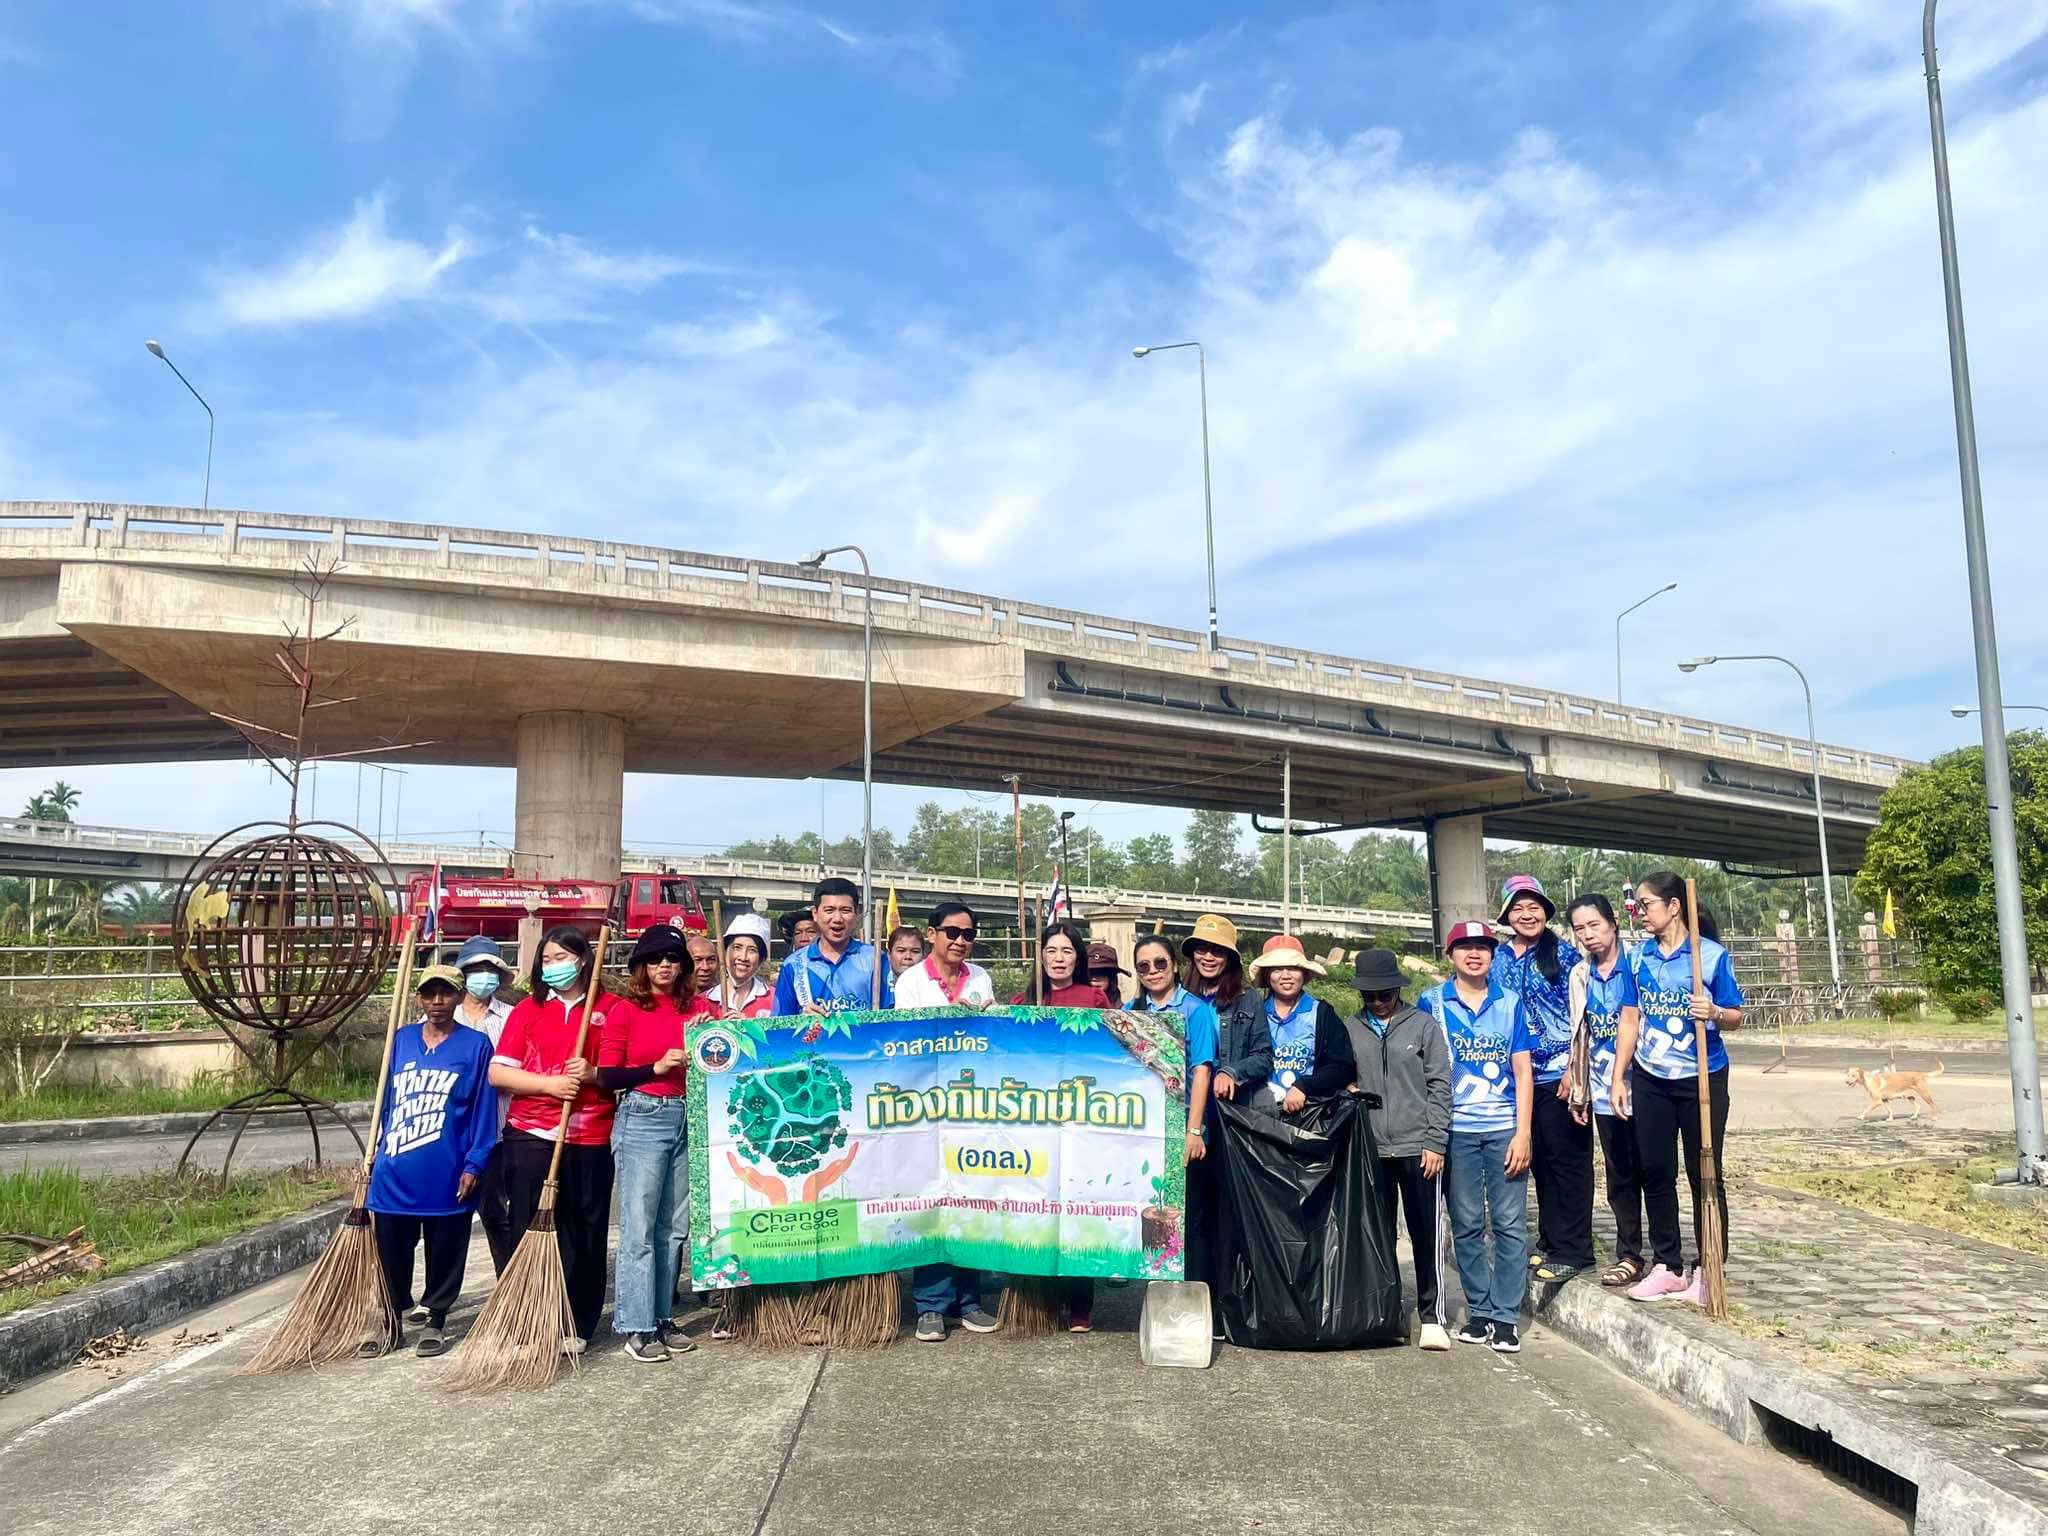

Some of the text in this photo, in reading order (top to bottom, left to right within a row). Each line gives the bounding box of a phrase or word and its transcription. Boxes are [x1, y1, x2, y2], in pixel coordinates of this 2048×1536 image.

[884, 1030, 989, 1056] อาสาสมัคร
[866, 1069, 1146, 1129] ท้องถิ่นรักษ์โลก
[750, 1208, 838, 1234] Change
[771, 1219, 839, 1233] For Good
